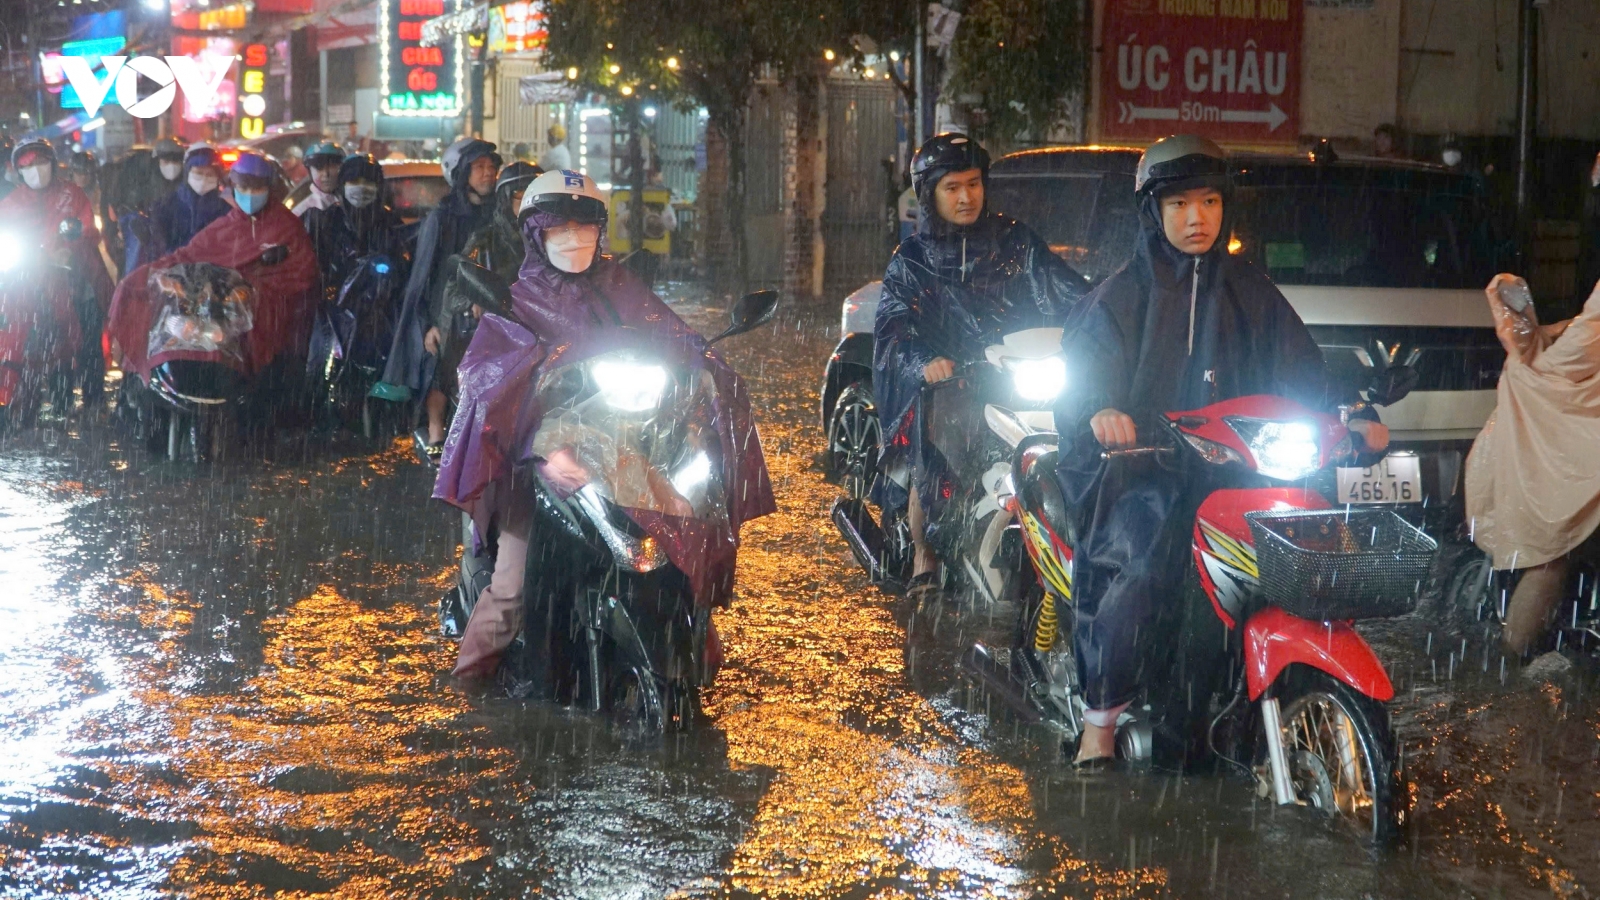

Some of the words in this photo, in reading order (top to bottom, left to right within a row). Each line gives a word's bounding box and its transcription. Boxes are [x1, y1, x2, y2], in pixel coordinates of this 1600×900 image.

[1118, 33, 1170, 91] ÚC
[1184, 39, 1287, 95] CHÂU
[1181, 102, 1221, 122] 50m
[1349, 481, 1411, 501] 466.16
